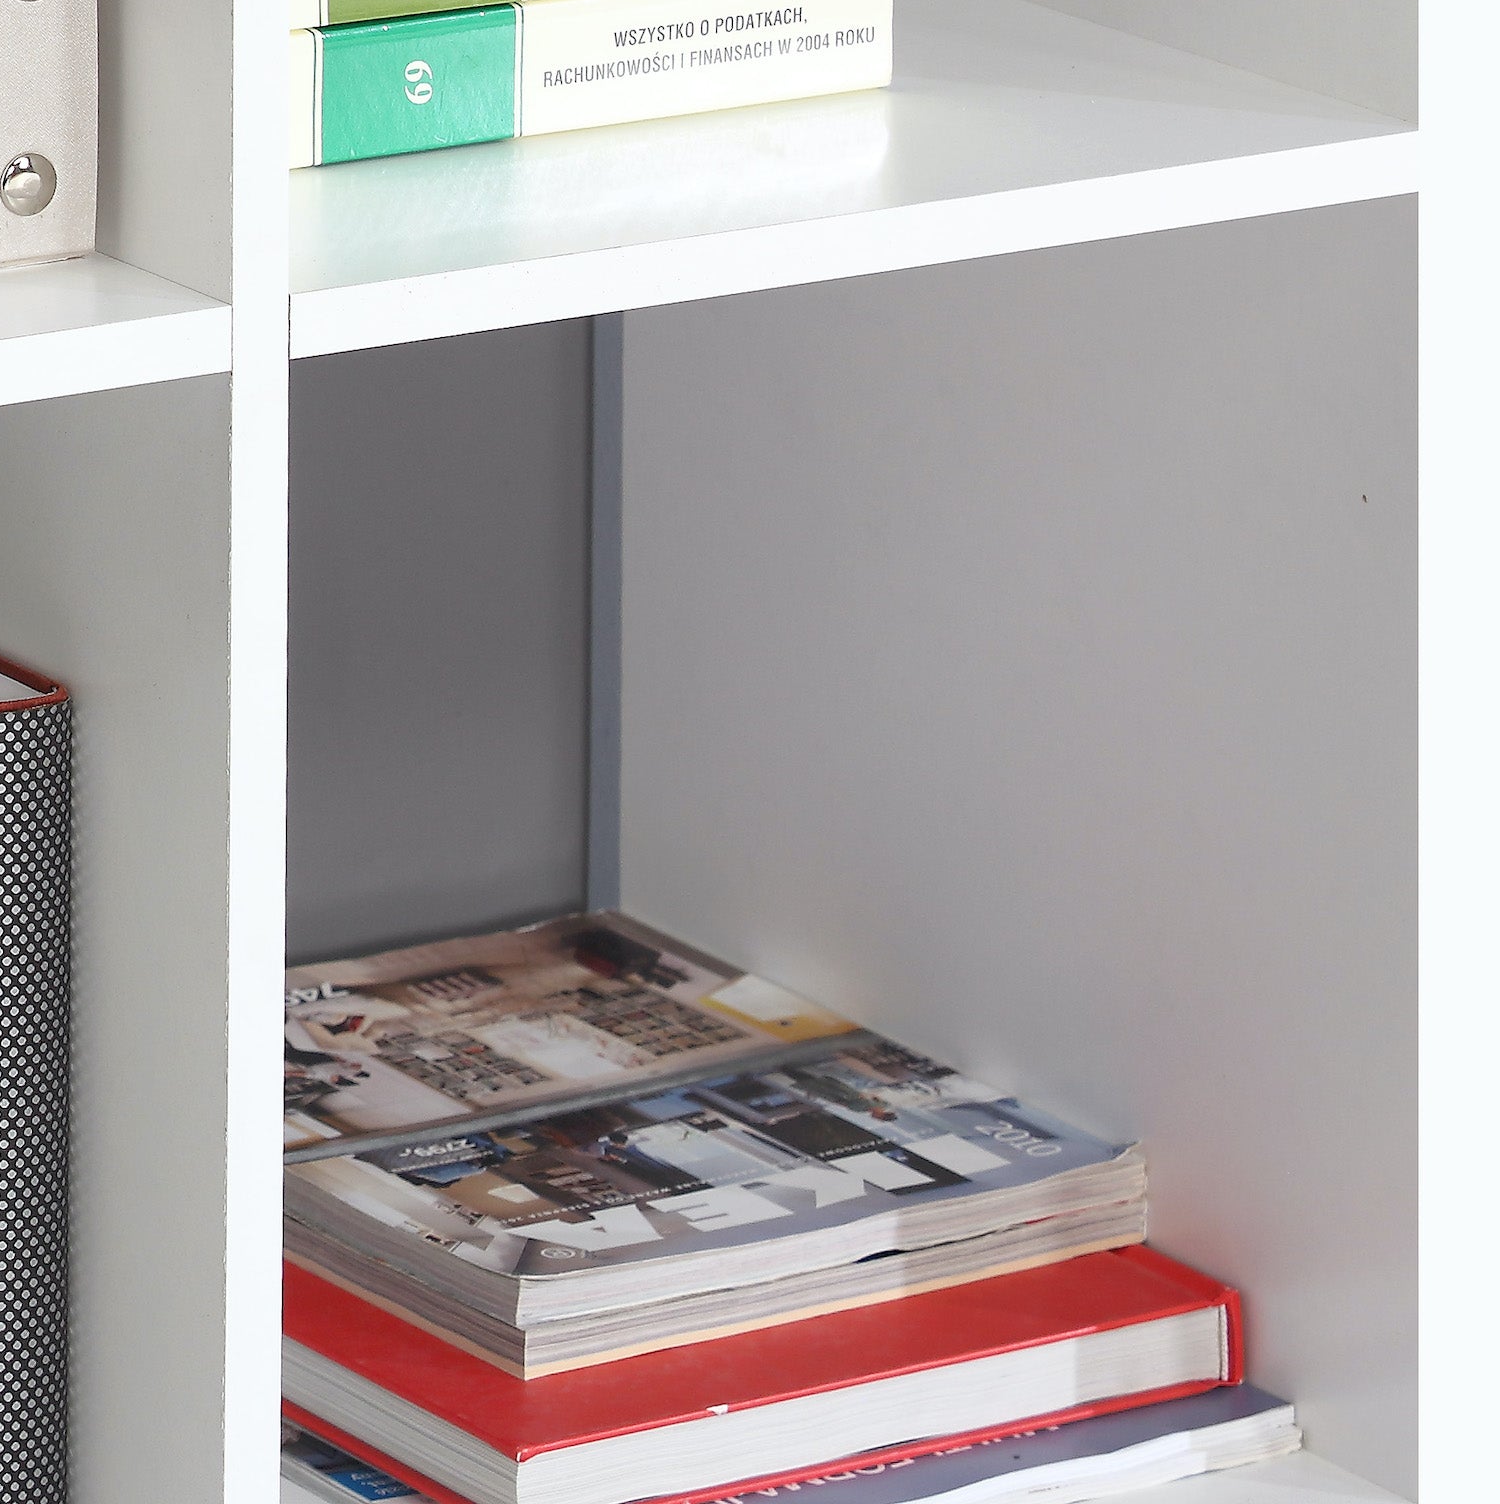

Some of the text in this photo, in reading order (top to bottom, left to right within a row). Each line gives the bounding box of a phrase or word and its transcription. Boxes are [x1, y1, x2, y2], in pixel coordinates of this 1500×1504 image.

[613, 6, 809, 48] WSZYSTKO O PODATKACH,
[404, 59, 434, 105] 69
[543, 51, 676, 88] RACHUNKOWOŚCI
[689, 39, 774, 68] FINANSACH
[778, 38, 793, 56] W
[796, 32, 830, 53] 2004
[835, 25, 877, 48] ROKU
[504, 1133, 1013, 1253] IKEA
